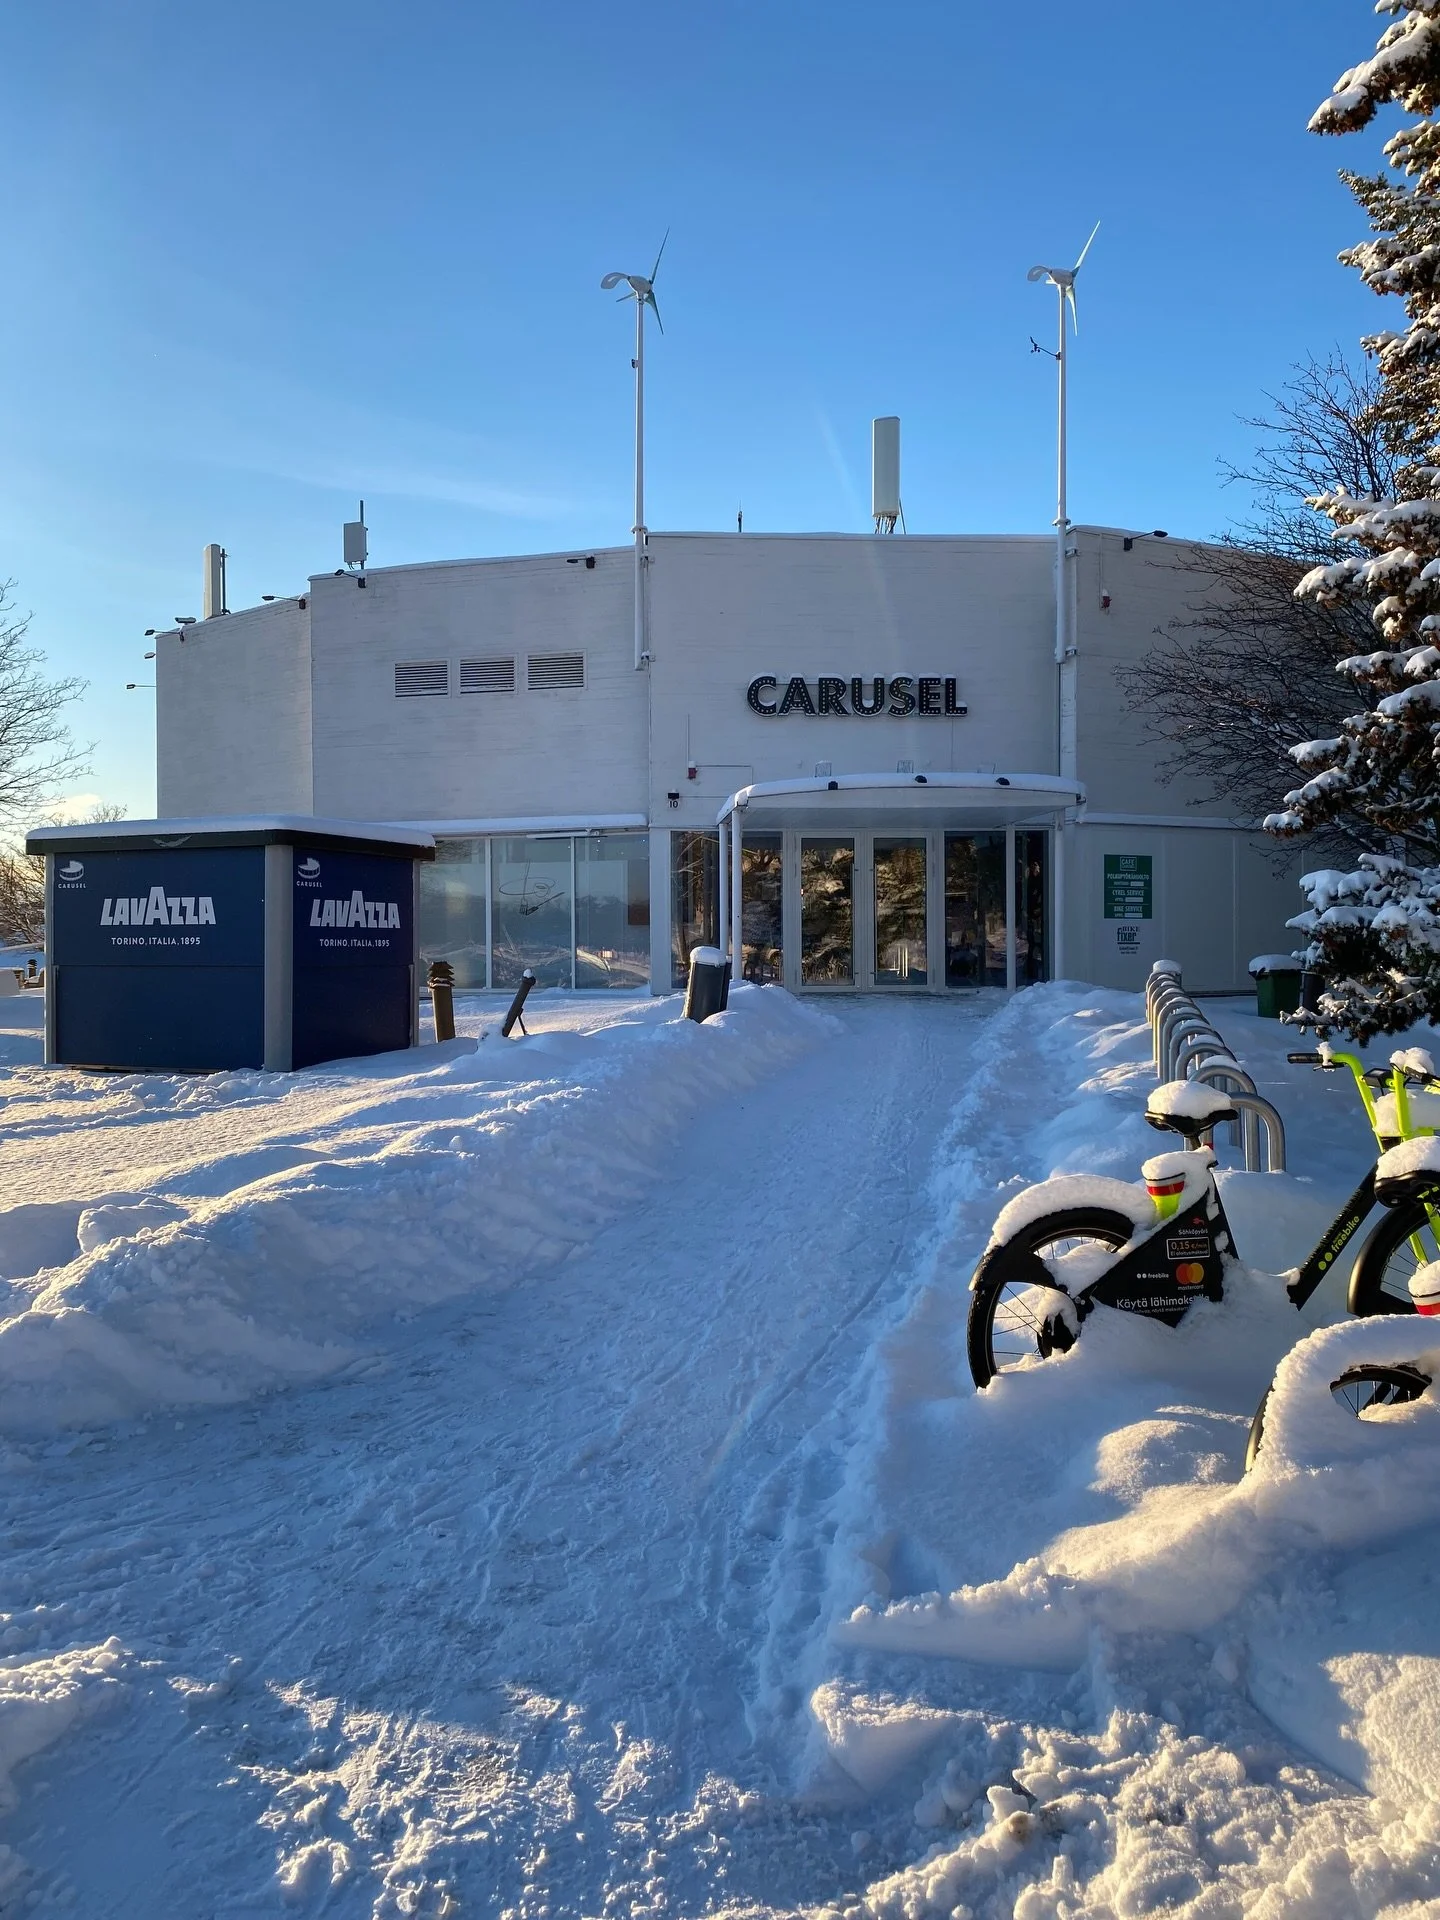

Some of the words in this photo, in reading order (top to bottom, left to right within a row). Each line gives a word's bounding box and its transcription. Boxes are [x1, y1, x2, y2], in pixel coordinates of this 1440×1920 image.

[747, 674, 968, 717] CARUSEL
[670, 800, 679, 809] 10
[100, 886, 217, 926] LAVAZZA
[309, 890, 401, 929] LAVAZZA
[181, 937, 201, 945] 1895
[375, 939, 390, 947] 1895
[1331, 1215, 1360, 1253] freebike
[1170, 1241, 1190, 1250] 0,15
[1116, 1298, 1148, 1310] Käytä
